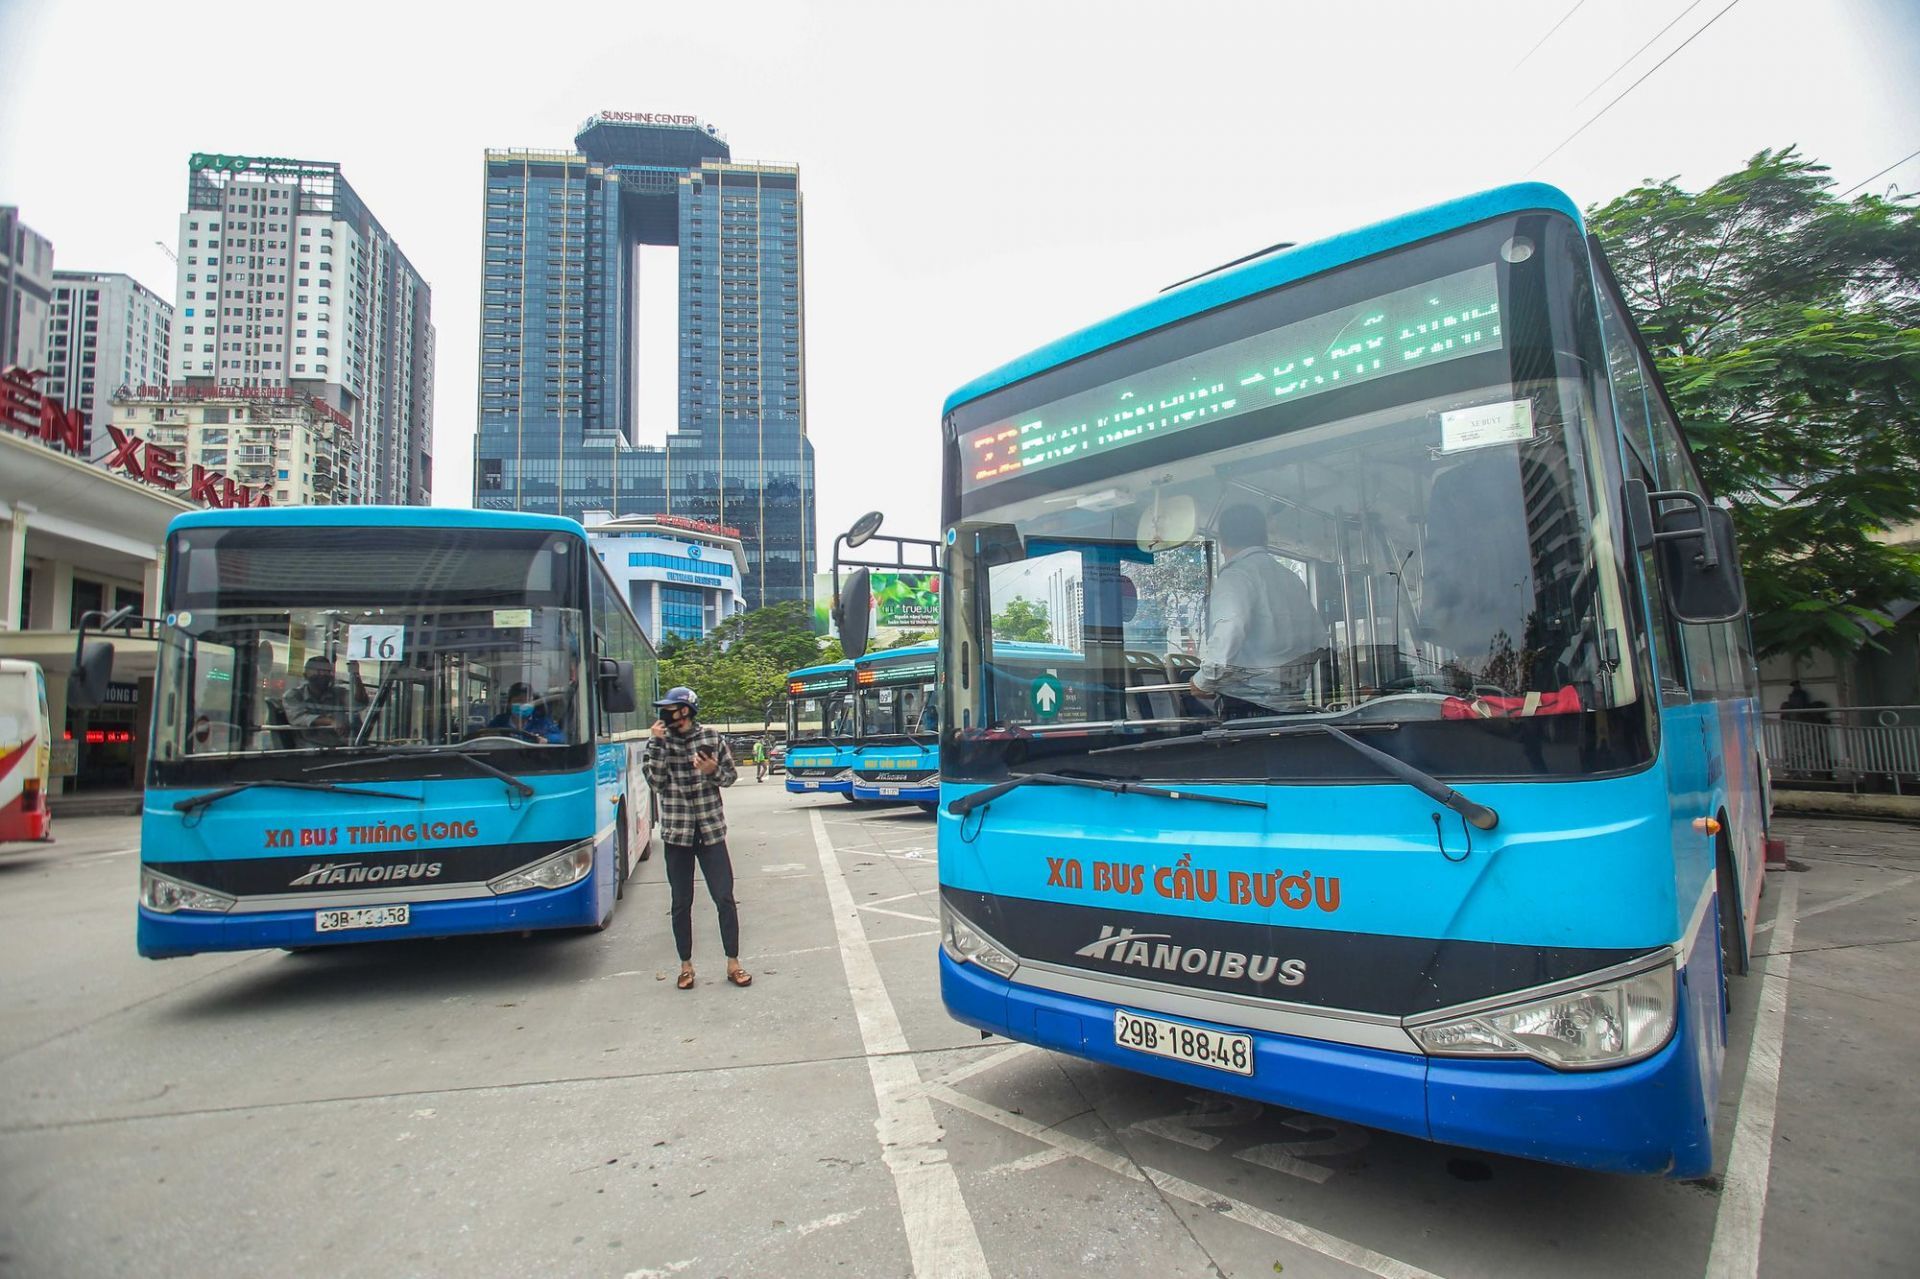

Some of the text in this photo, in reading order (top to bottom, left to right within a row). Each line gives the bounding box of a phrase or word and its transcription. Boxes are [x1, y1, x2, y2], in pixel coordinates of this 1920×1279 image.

[601, 110, 695, 125] SUNSHINE CENTER
[105, 424, 177, 490] XE
[361, 634, 396, 659] 16
[264, 819, 479, 848] XN BUS THĂNG LONG
[288, 861, 443, 887] HANOIBUS
[1046, 853, 1341, 913] XN BUS CẦU BƯƠU
[1075, 925, 1307, 987] HANOIBUS
